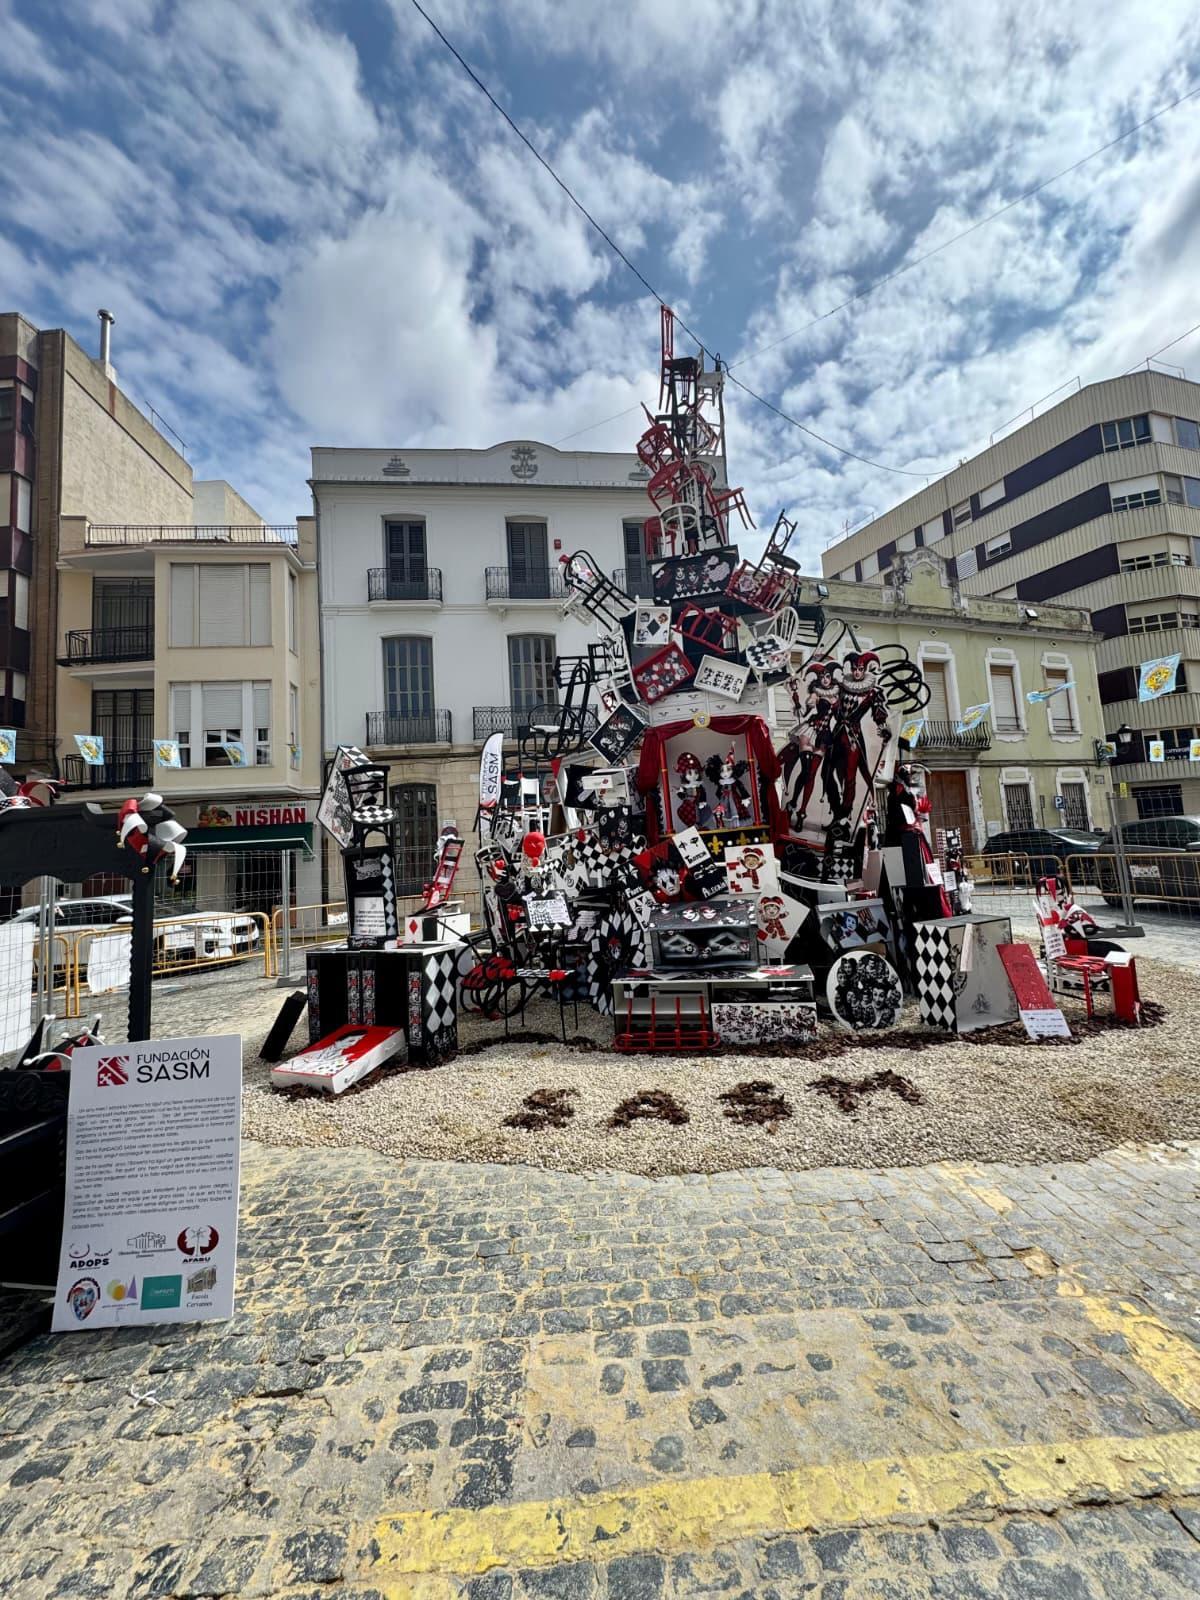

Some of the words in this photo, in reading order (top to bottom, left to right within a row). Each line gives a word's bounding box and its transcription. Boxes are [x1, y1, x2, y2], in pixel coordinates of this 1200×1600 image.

[487, 754, 499, 794] SASM
[1055, 797, 1062, 807] P
[236, 808, 306, 826] NISHAN
[136, 1047, 210, 1065] FUNDACIÓN
[136, 1060, 210, 1084] SASM
[69, 1258, 110, 1269] ADOPS
